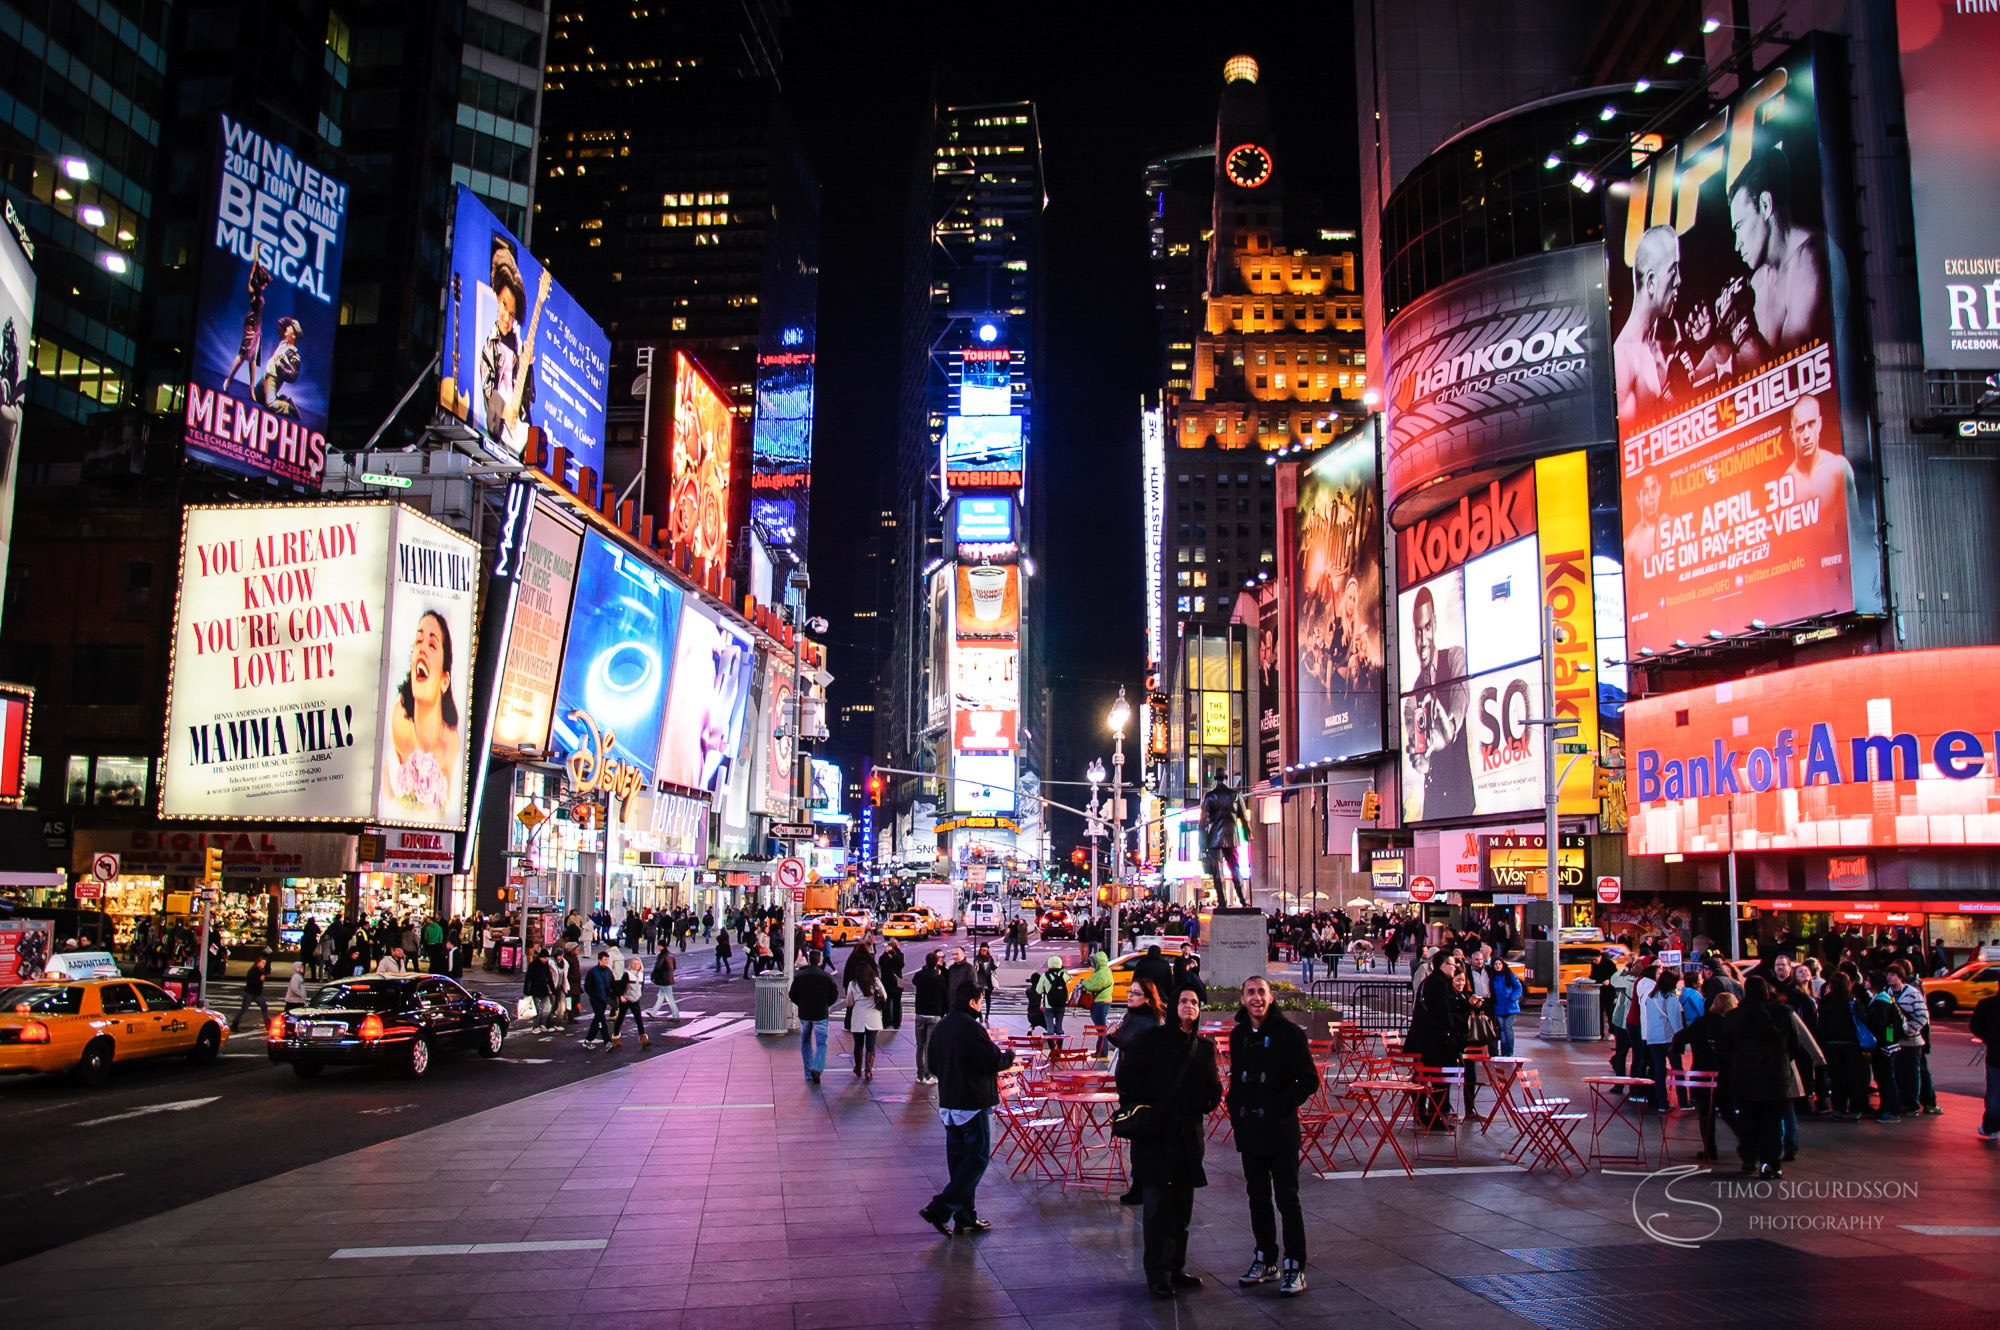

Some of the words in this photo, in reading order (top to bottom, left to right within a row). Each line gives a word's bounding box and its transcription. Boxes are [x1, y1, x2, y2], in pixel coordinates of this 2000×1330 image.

[222, 114, 345, 214] WINNER!
[224, 150, 259, 185] 2010
[263, 170, 296, 206] TONY
[298, 192, 339, 230] AWARD
[220, 171, 336, 272] BEST
[216, 220, 331, 303] MUSICAL
[962, 350, 1010, 361] TOSHIBA
[1436, 375, 1490, 404] driving
[1494, 358, 1586, 385] emotion
[1661, 382, 1732, 422] WELTERWEIGHT
[1738, 338, 1820, 384] CHAMPIONSHIP
[186, 382, 326, 472] MEMPHIS
[1624, 404, 1718, 473] ST-PIERRE
[1734, 349, 1832, 424] SHIELDS
[190, 429, 262, 460] TELECHARGE.COM
[1669, 466, 1688, 478] WORLD
[1690, 446, 1736, 472] FEATHERWEIGHT
[1736, 426, 1782, 451] CHAMPIONSHIP
[948, 471, 1022, 486] TOSHIBA
[1151, 466, 1159, 502] WITH
[1669, 470, 1706, 500] ALDO
[1714, 435, 1784, 482] HOMINICK
[1152, 505, 1162, 546] FIRST
[1660, 512, 1696, 550] SAT.
[1700, 490, 1760, 536] APRIL
[1764, 474, 1796, 514] 30
[197, 539, 244, 578] YOU
[252, 522, 360, 570] ALREADY
[1406, 480, 1518, 584] Kodak
[1643, 550, 1676, 580] LIVE
[1678, 539, 1699, 568] ON
[1701, 497, 1820, 562] PAY-PER-VIEW
[399, 543, 444, 588] MAMMA
[446, 552, 470, 592] MIA!
[522, 561, 532, 582] IT
[527, 540, 554, 572] YOU'VE
[552, 551, 573, 583] MADE
[1153, 552, 1162, 573] DO
[1727, 549, 1752, 570] UFC
[1744, 558, 1805, 584] twitter.com/ufc
[243, 567, 316, 610] KNOW
[519, 584, 536, 606] BUT
[535, 590, 552, 616] WILL
[1154, 578, 1162, 608] YOU
[192, 612, 280, 656] YOU'RE
[288, 599, 372, 643] GONNA
[516, 604, 532, 628] YOU
[532, 610, 542, 634] BE
[541, 616, 561, 641] ABLE
[1545, 549, 1590, 718] Kodak
[513, 625, 524, 648] TO
[524, 630, 550, 658] RETIRE
[233, 648, 296, 690] LOVE
[302, 642, 335, 680] IT!
[508, 648, 553, 681] ANYWHERE?
[236, 707, 272, 718] ANDERSSON
[1206, 711, 1226, 724] LION
[1208, 702, 1224, 710] THE
[1264, 708, 1274, 719] THE
[1325, 714, 1342, 728] MARCH
[1342, 712, 1348, 724] 25
[1478, 679, 1531, 756] SO
[188, 715, 289, 766] MAMMA
[294, 704, 354, 754] MIA!
[1206, 724, 1226, 738] KING
[1564, 744, 1570, 752] W
[1572, 745, 1579, 753] 46
[262, 758, 288, 768] MUSICAL
[1481, 732, 1532, 772] Kodak
[1637, 738, 1740, 802] Bank
[1747, 729, 1794, 793] of
[650, 791, 703, 838] FOREVER
[806, 800, 812, 808] W
[812, 800, 820, 808] 46
[131, 832, 278, 852] DIGITAL
[402, 832, 442, 849] DIGITAL
[1372, 850, 1404, 859] MARQUIS
[1489, 836, 1585, 848] MARQIS
[1828, 856, 1867, 880] Marriott
[68, 957, 113, 970] AADVANTAGE
